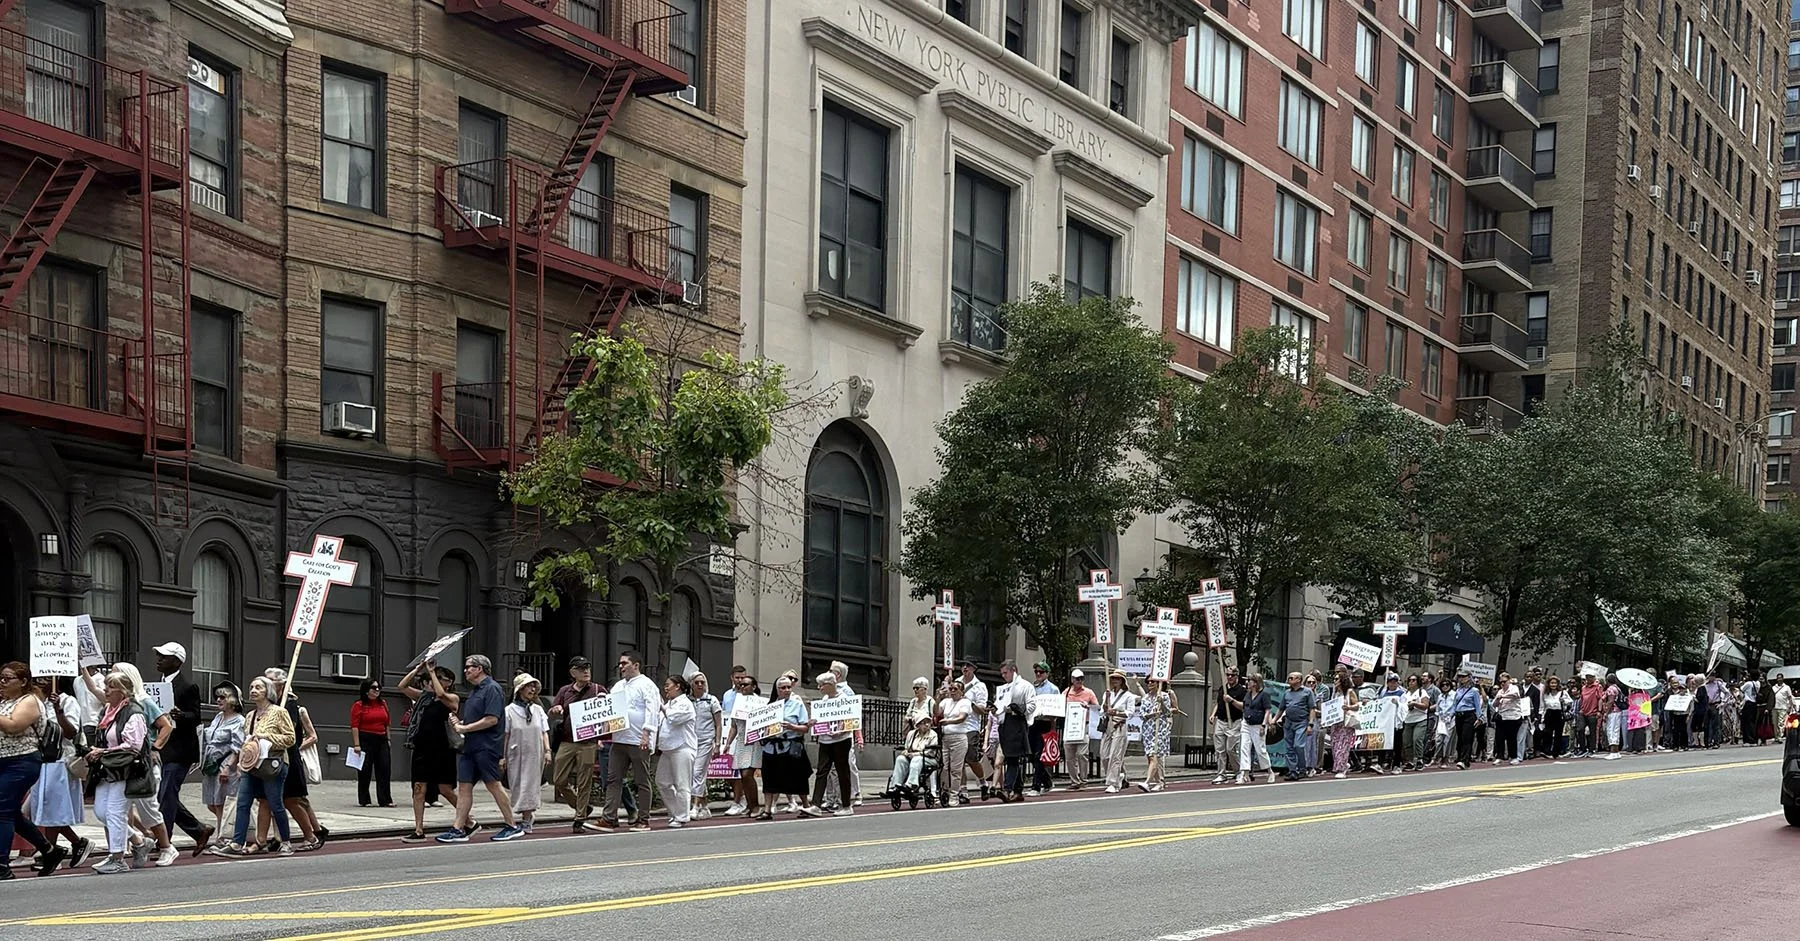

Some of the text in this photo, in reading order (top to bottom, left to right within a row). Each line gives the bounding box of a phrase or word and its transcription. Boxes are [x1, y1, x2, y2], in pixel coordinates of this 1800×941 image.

[857, 5, 1107, 163] NEW YORK PVBLIC LIBRARY
[308, 567, 331, 576] CREATION
[34, 630, 68, 640] stranger
[60, 641, 73, 649] you
[1346, 640, 1379, 655] Immigrants
[152, 684, 160, 696] is
[583, 697, 612, 711] Life is
[826, 698, 859, 708] neighbors
[1374, 700, 1383, 713] is
[581, 706, 617, 723] sacred.
[748, 703, 782, 719] Our neighbors
